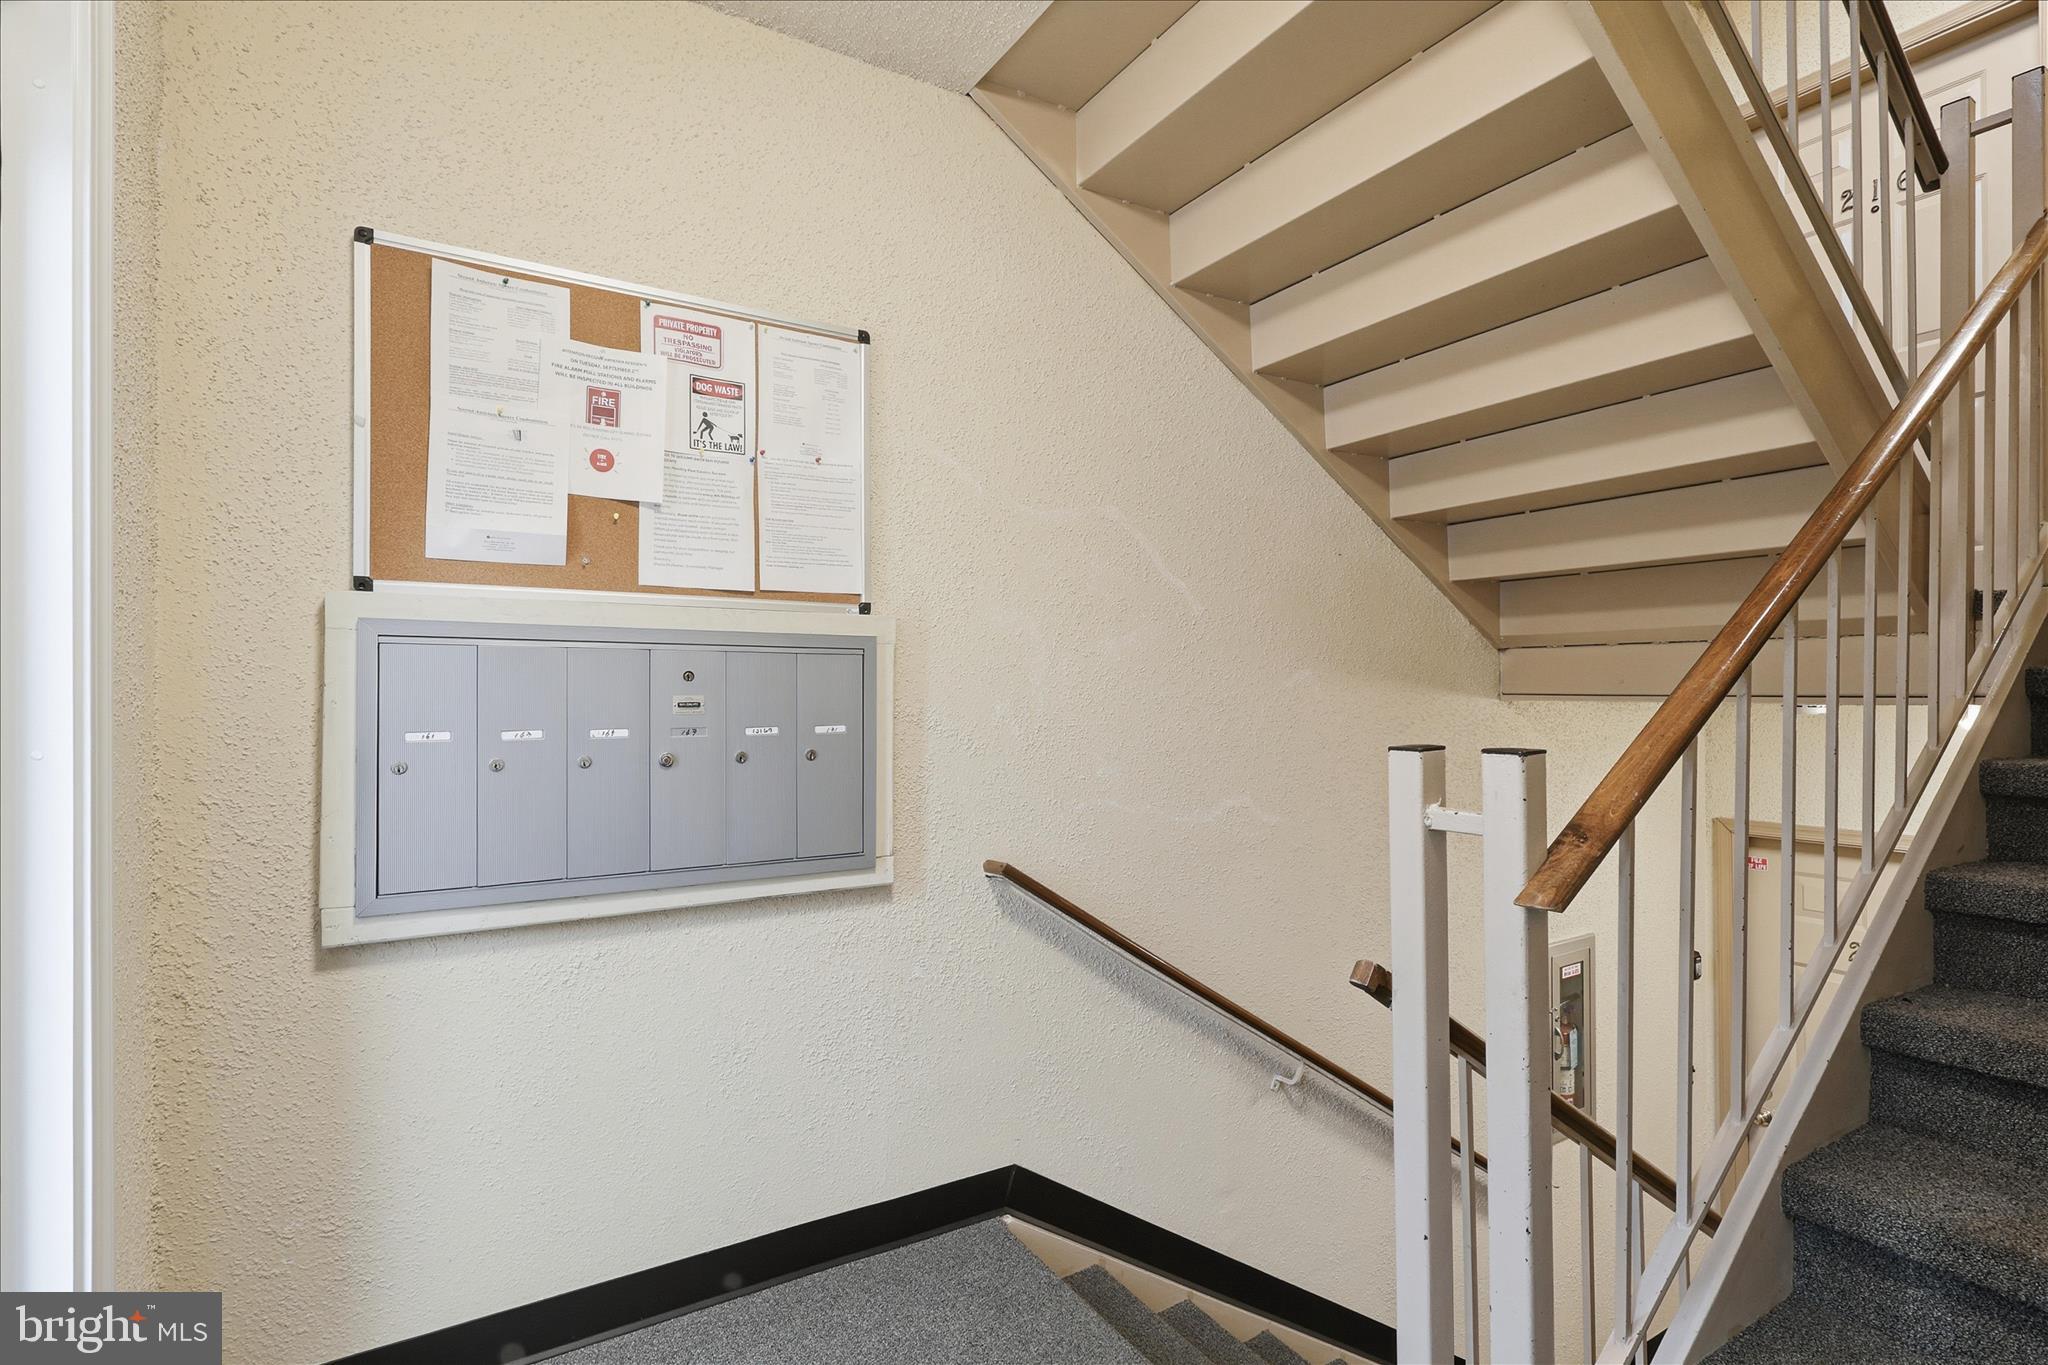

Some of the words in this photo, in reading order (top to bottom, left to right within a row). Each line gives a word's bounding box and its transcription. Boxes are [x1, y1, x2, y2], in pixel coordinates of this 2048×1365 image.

[659, 319, 686, 331] PRIVATE
[686, 324, 718, 336] PROPERTY
[664, 337, 713, 352] TRESPASSING
[695, 382, 713, 393] DOG
[714, 385, 741, 397] WASTE
[592, 396, 615, 408] FIRE
[693, 439, 707, 449] IT'S
[709, 441, 723, 451] THE
[724, 443, 743, 453] LAW!
